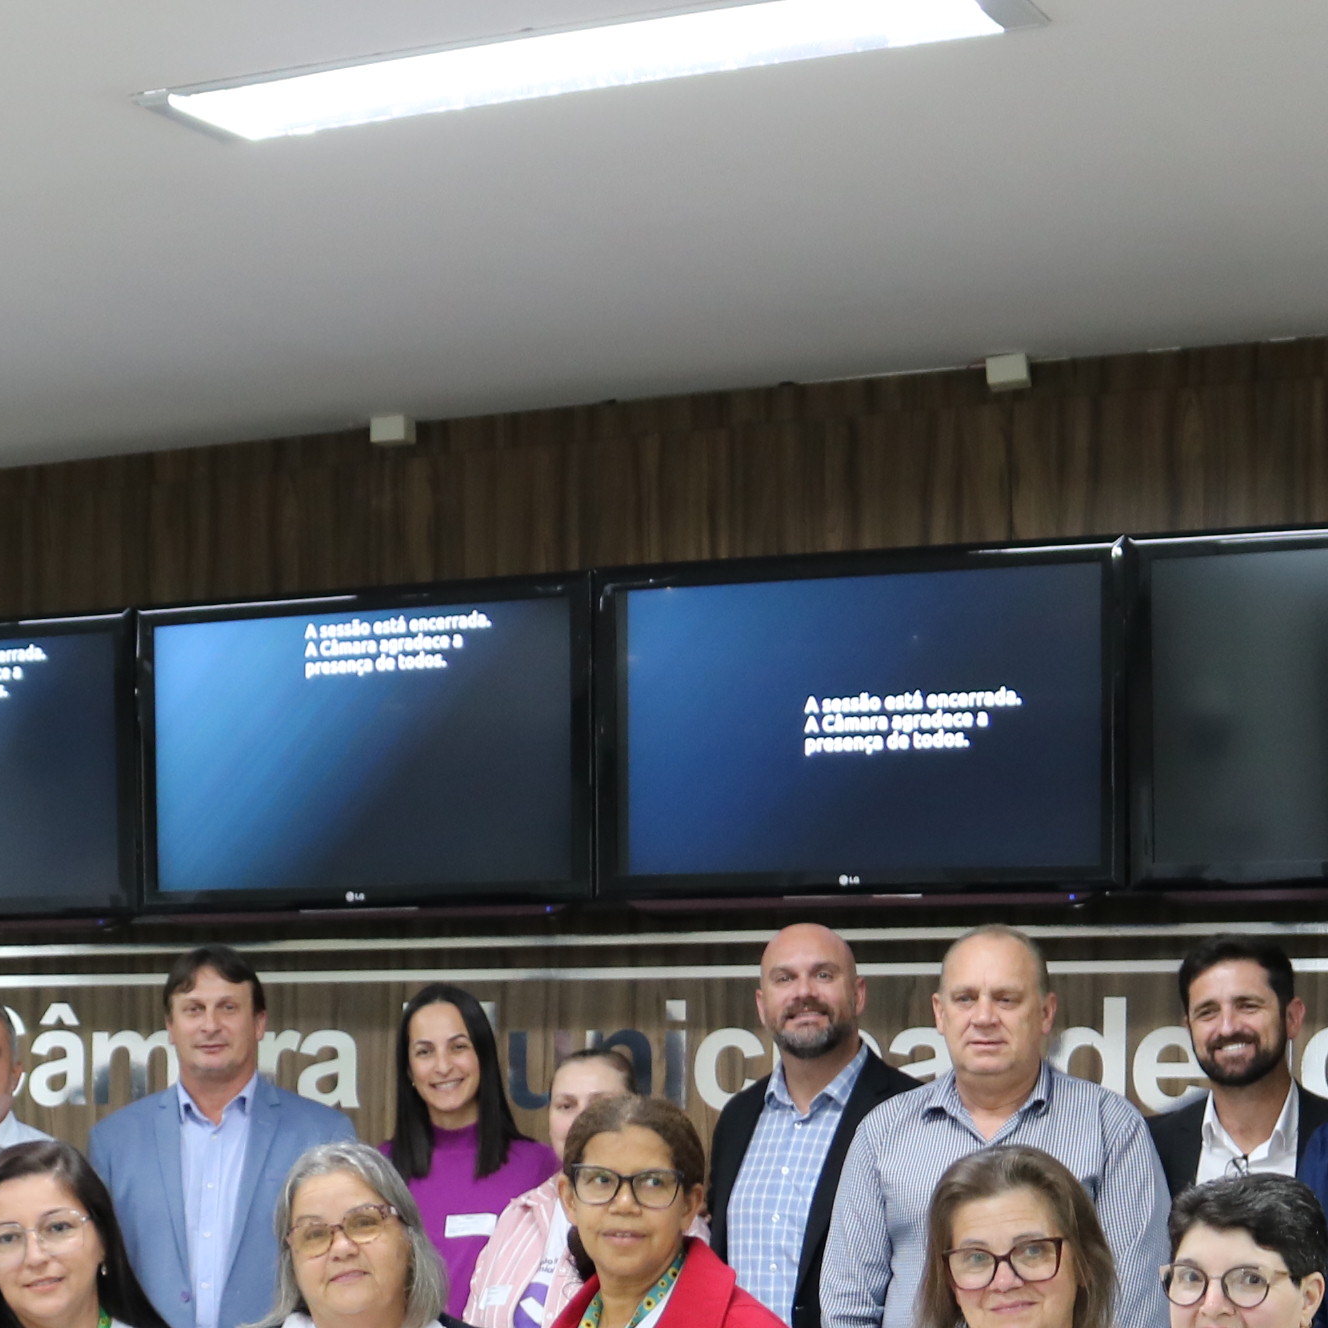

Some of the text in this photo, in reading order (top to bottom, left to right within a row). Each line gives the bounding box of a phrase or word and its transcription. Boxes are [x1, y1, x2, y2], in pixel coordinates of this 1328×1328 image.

[305, 609, 492, 640] A sessão está encerrada.
[305, 632, 463, 658] A Câmara agradece a
[12, 665, 23, 680] a
[305, 651, 448, 679] presença de todos.
[804, 685, 1023, 714] A sessão está encerrada.
[804, 708, 989, 734] A Câmara agradece a
[804, 728, 970, 757] presença de todos.
[1048, 997, 1207, 1112] de
